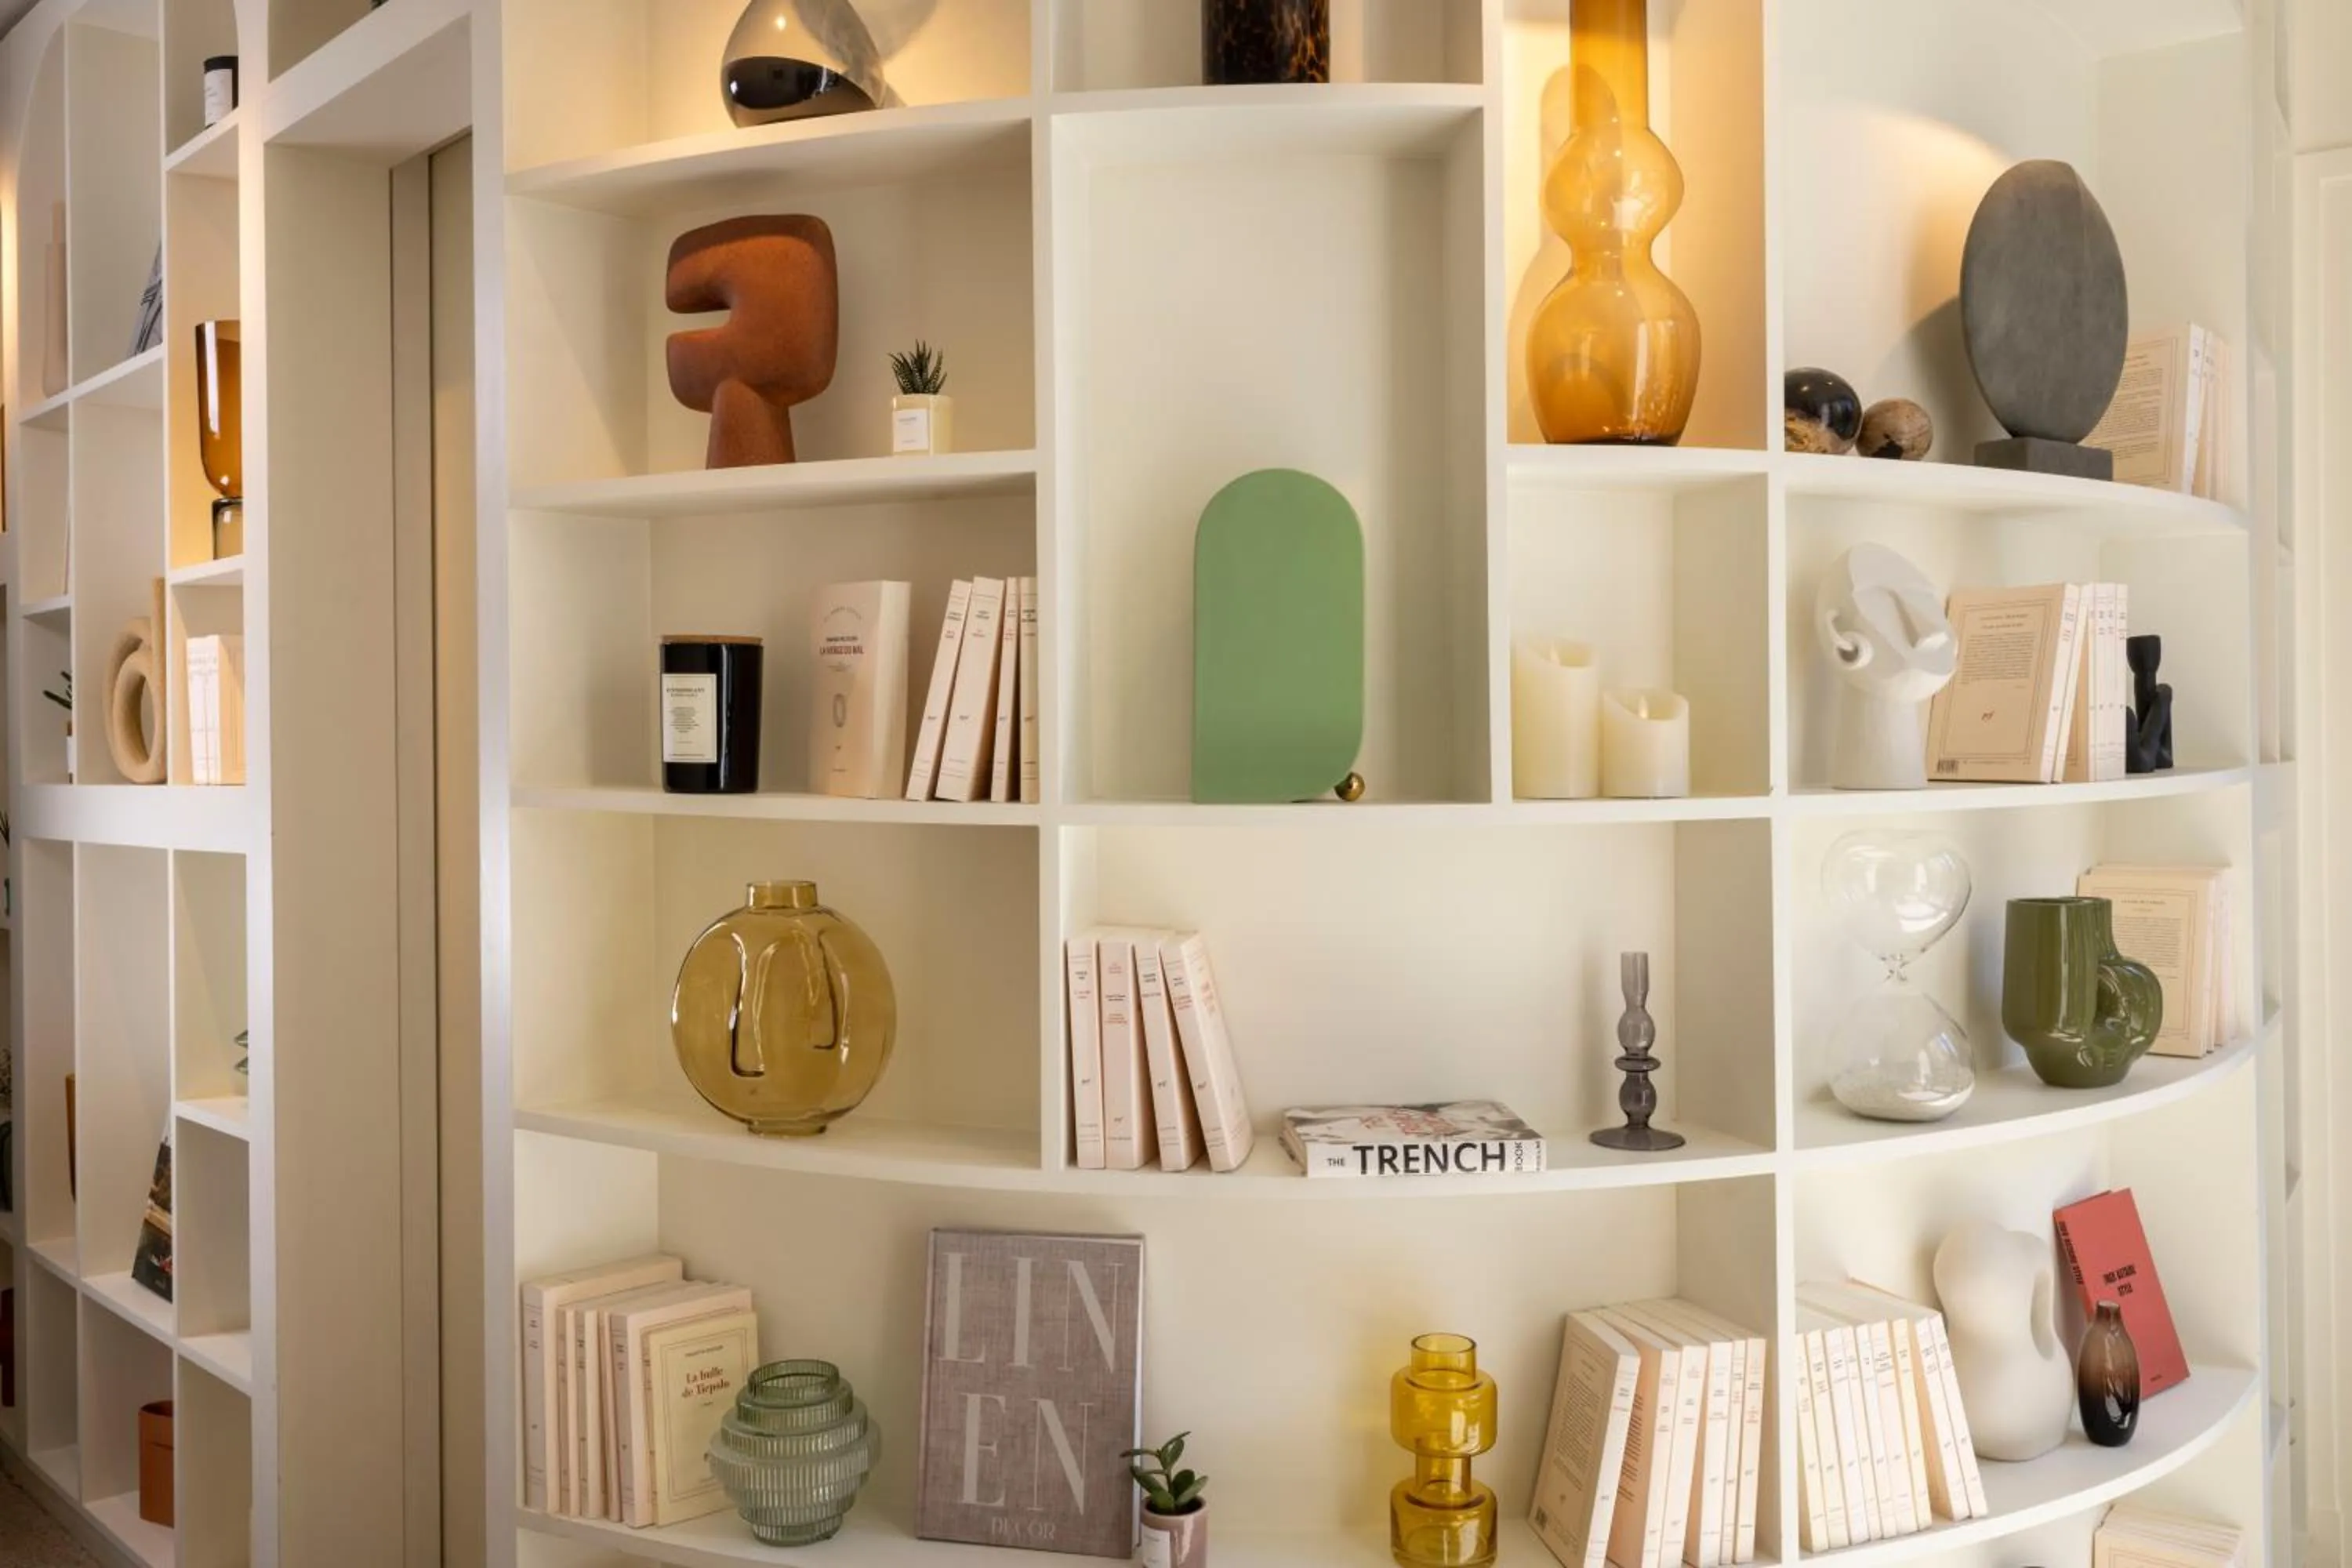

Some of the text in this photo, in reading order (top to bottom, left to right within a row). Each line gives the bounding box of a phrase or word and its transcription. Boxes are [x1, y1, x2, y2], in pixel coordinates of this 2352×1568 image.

[1327, 1156, 1345, 1167] THE
[1352, 1142, 1506, 1175] TRENCH
[938, 1251, 1125, 1374] LIN
[958, 1392, 1094, 1516] EN
